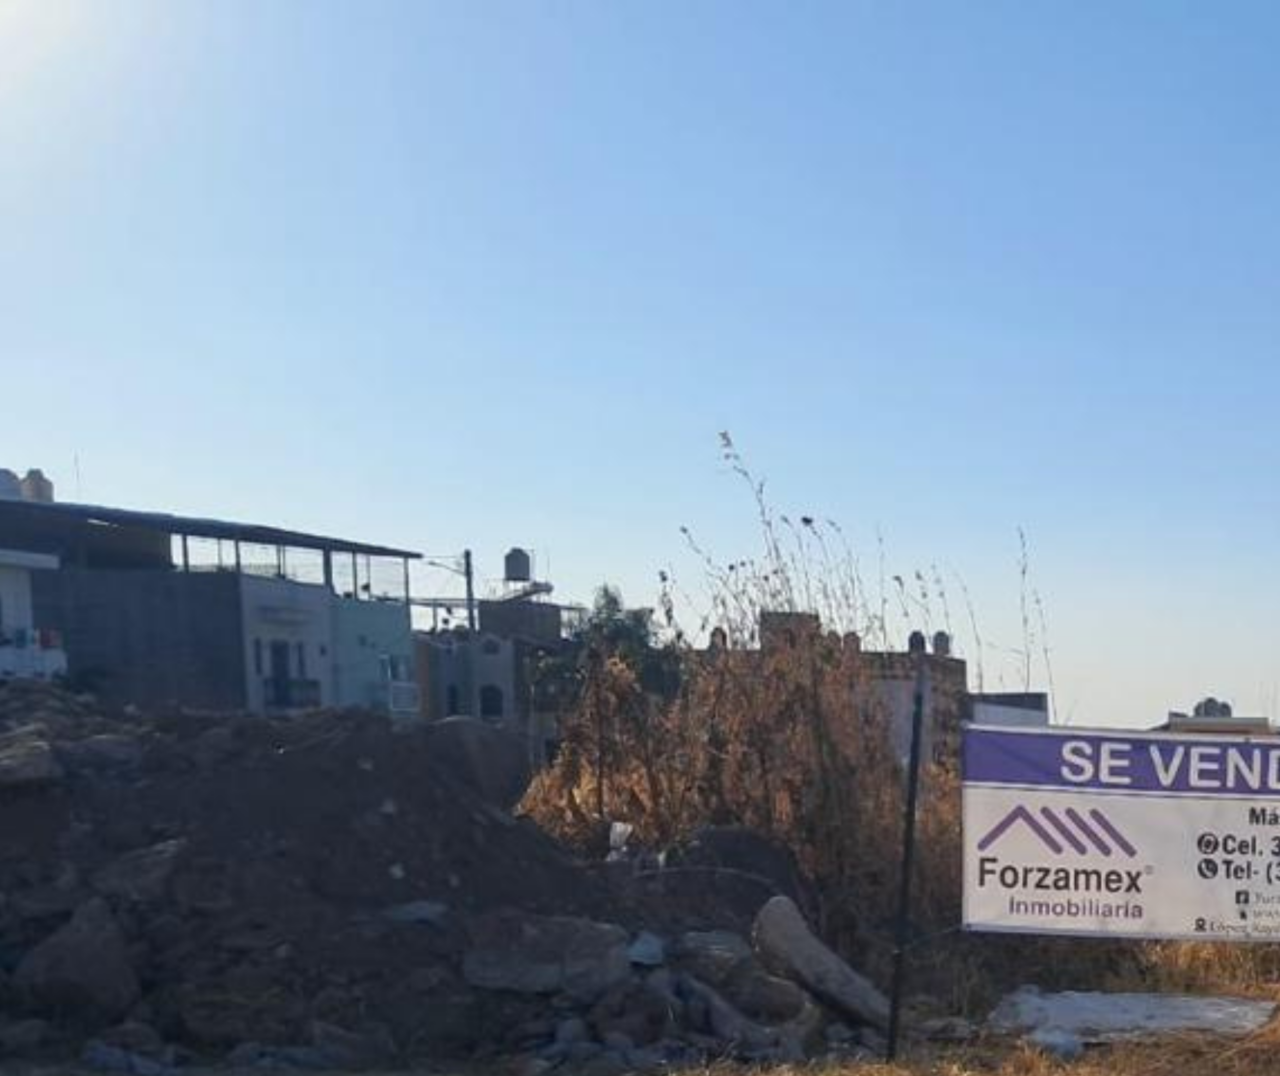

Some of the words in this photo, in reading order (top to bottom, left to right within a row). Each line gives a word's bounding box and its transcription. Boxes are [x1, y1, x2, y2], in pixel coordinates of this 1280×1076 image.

[1060, 741, 1132, 785] SE
[1222, 834, 1264, 857] Cel.
[979, 858, 1142, 893] Forzamex
[1008, 897, 1144, 919] Inmobiliaria
